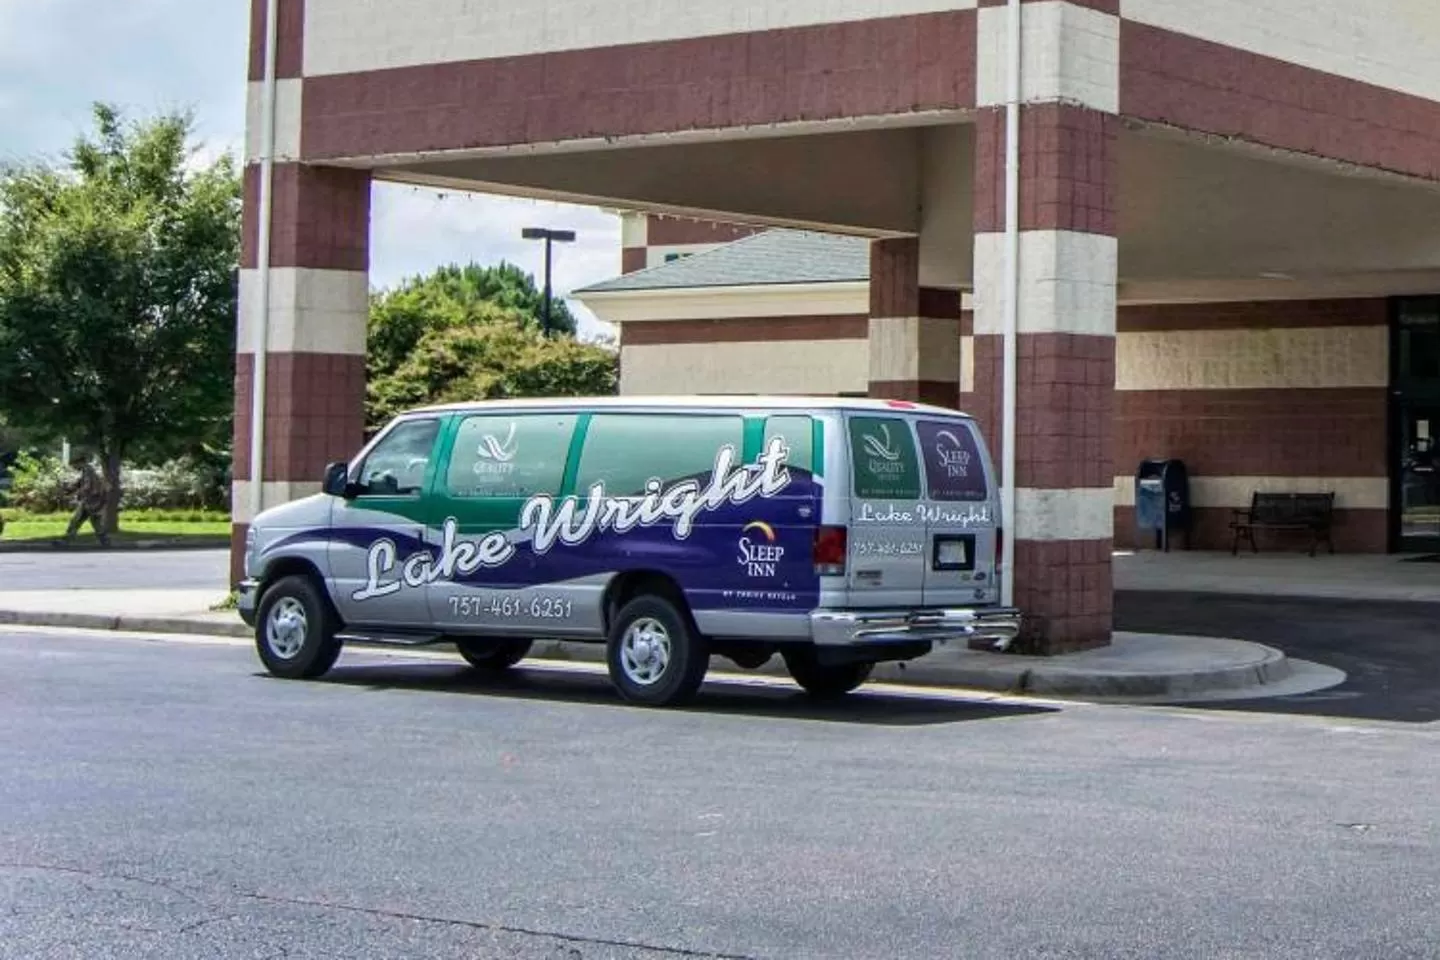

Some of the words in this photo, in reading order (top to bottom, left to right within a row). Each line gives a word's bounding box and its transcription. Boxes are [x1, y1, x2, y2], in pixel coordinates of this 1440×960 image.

[936, 443, 971, 468] SLEEP
[948, 465, 968, 478] INN
[352, 516, 514, 601] Lake
[518, 437, 791, 553] Wright
[858, 502, 913, 522] Lake
[916, 504, 990, 528] Wright
[737, 537, 784, 565] SLEEP
[747, 562, 775, 577] INN
[448, 595, 573, 618] 757-461-6251
